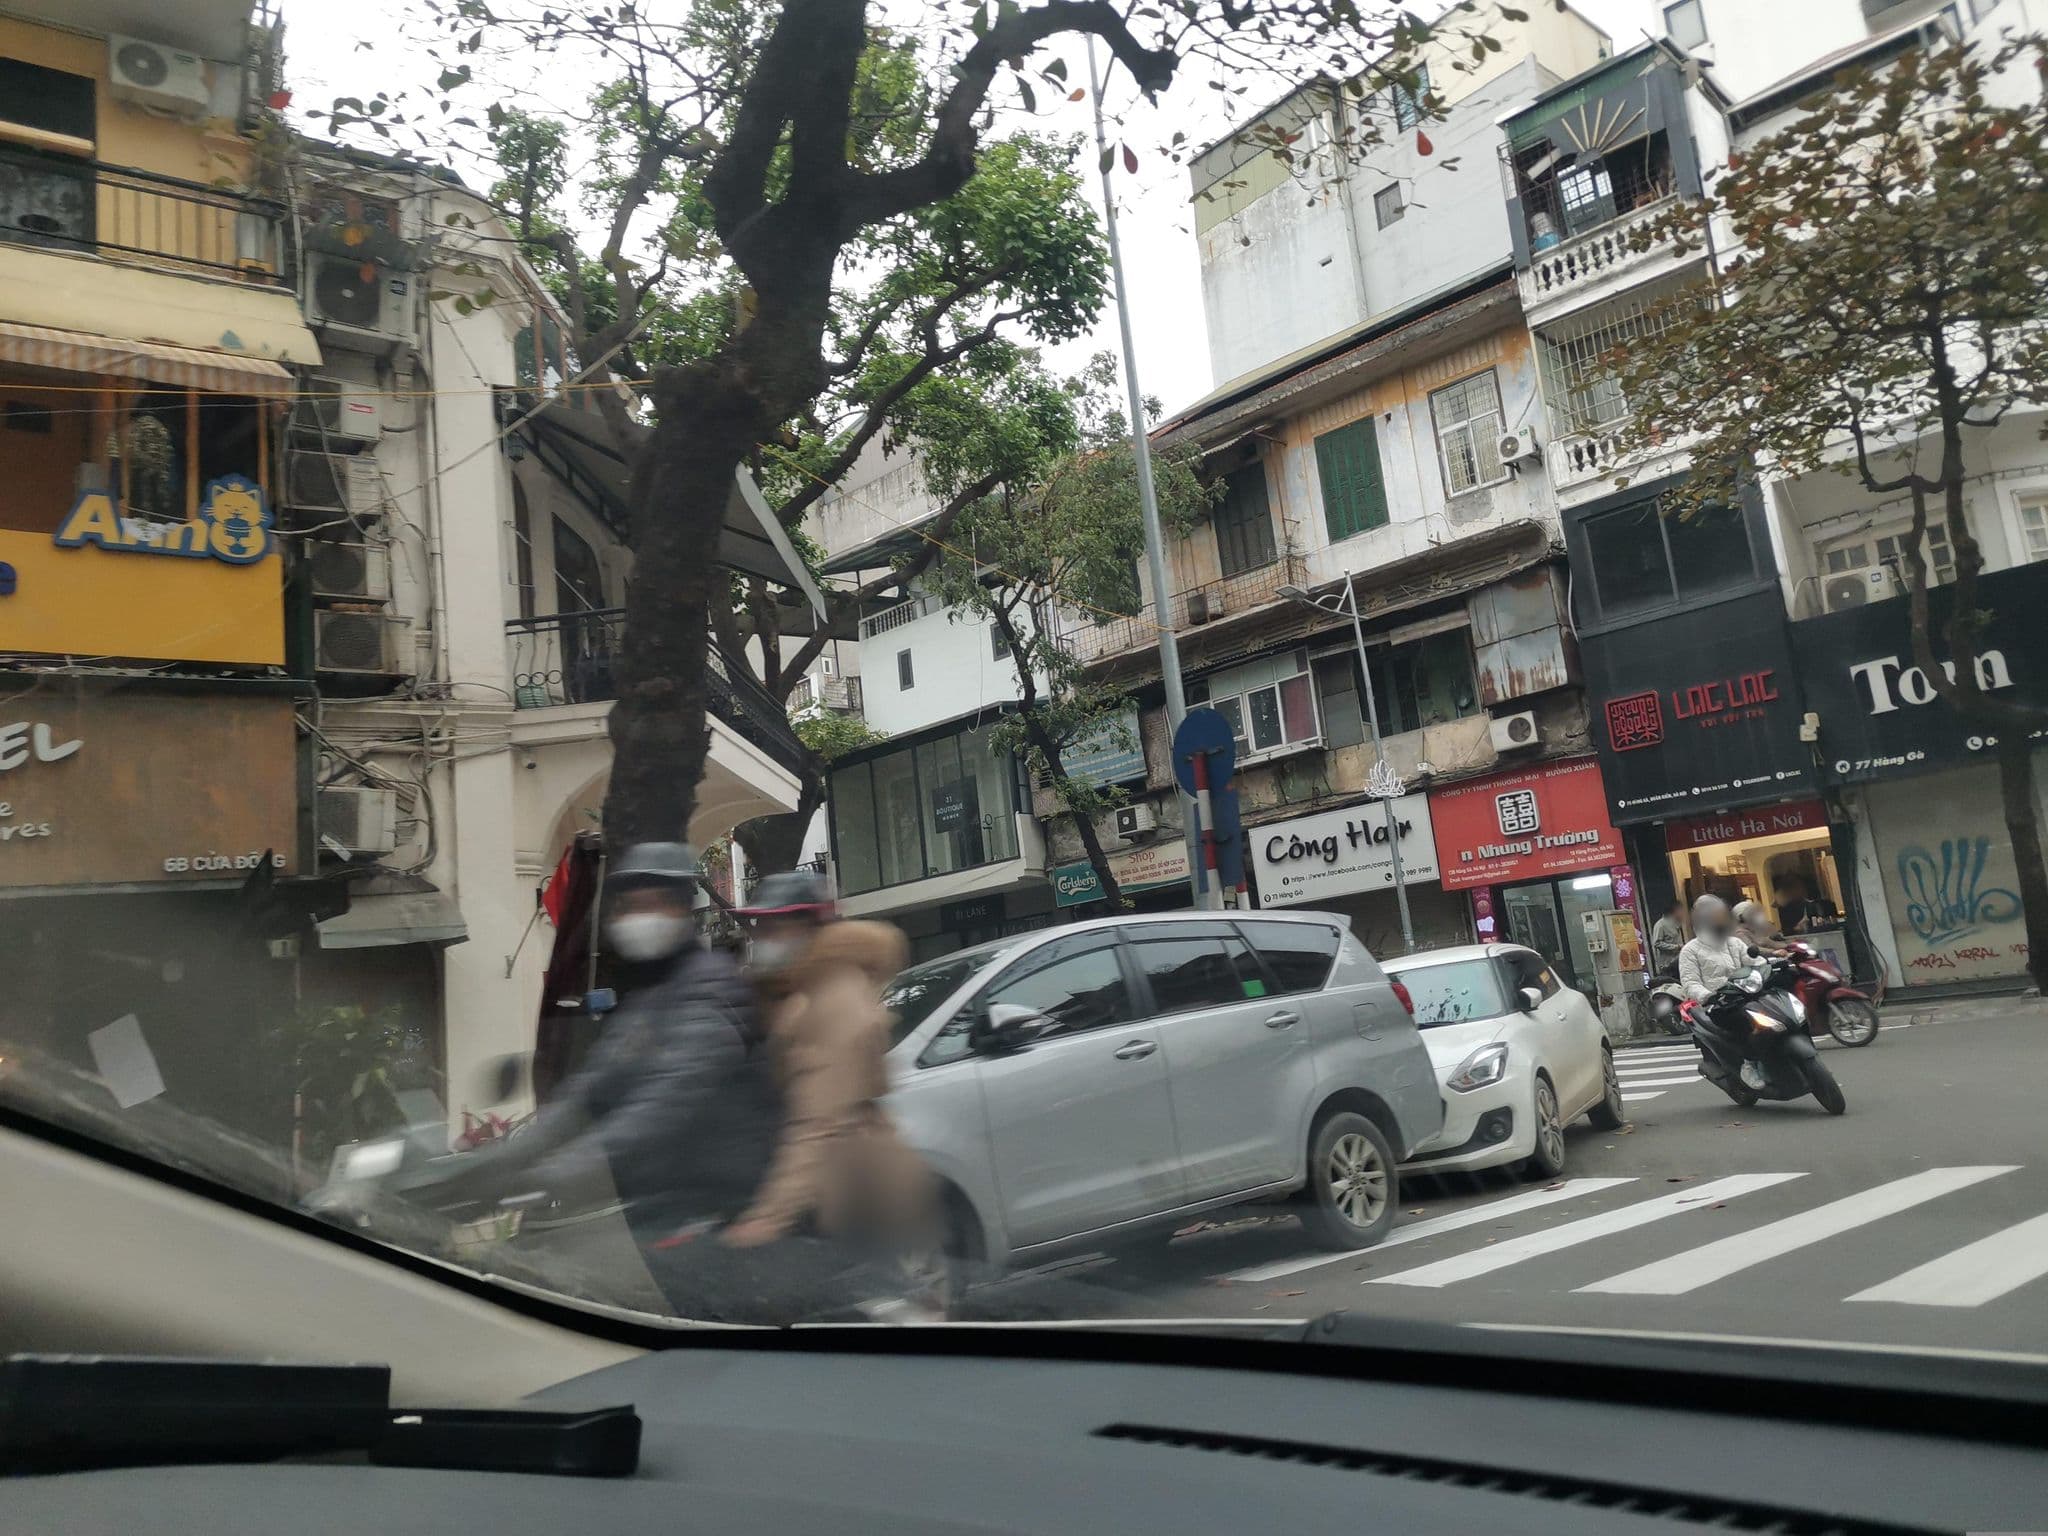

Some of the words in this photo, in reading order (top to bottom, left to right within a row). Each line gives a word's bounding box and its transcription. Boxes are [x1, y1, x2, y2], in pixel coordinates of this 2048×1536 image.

[1855, 760, 1870, 770] 77
[1693, 823, 1734, 843] Little
[1741, 818, 1766, 836] Ha
[1773, 812, 1803, 830] Noi
[1266, 833, 1339, 863] Công
[1478, 840, 1533, 860] Nhung
[1534, 828, 1599, 850] Trường
[163, 857, 189, 872] 6B
[192, 850, 233, 871] CỬA
[234, 850, 286, 869] ĐÔG
[1127, 850, 1155, 865] Shop
[1058, 875, 1097, 894] Carlsberg
